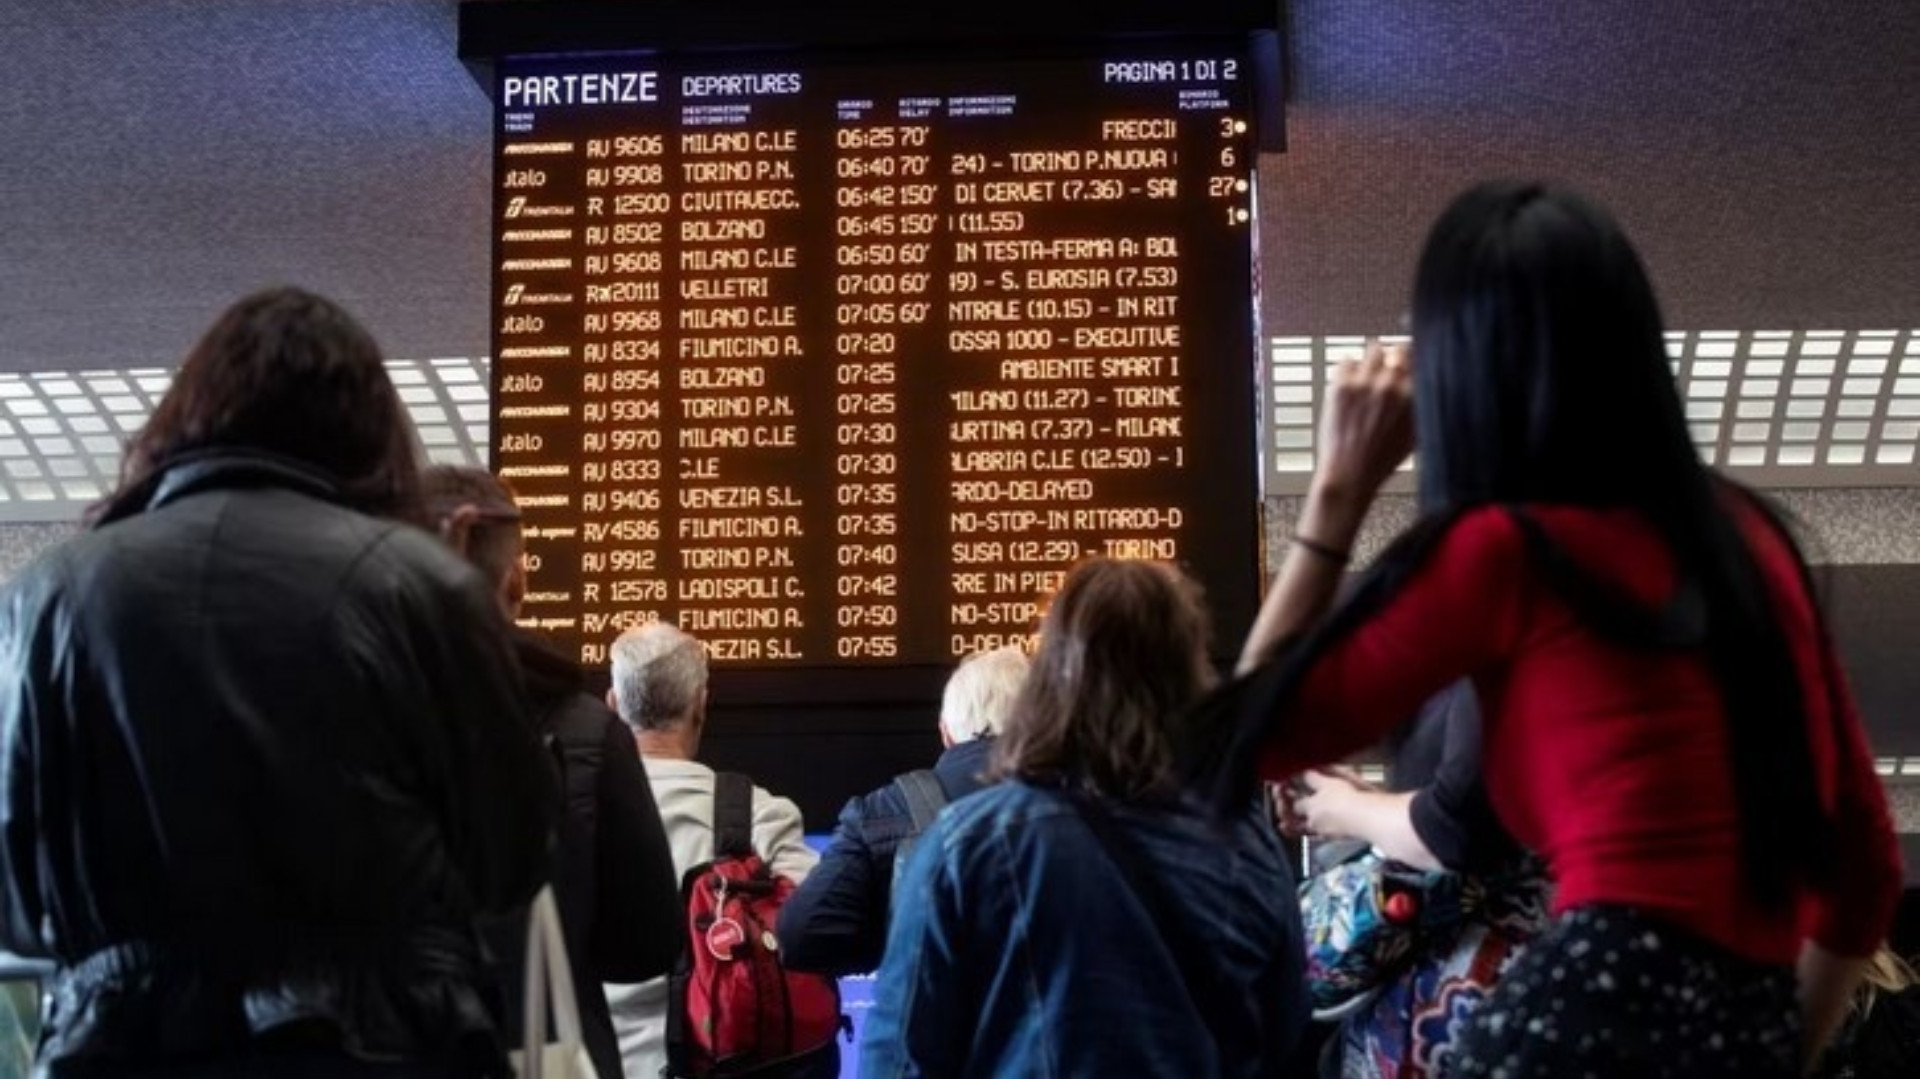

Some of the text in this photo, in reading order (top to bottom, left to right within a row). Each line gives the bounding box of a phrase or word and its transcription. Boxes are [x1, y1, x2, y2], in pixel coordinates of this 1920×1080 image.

[1104, 59, 1237, 82] PAGINA 1 DI 2
[504, 71, 657, 107] PARTENZE
[682, 73, 801, 97] DEPARTURES
[837, 126, 895, 149] 06:25
[1220, 117, 1233, 138] 3
[614, 135, 663, 157] 9606
[681, 130, 797, 154] MILANO C.LE
[837, 156, 895, 178] 06:40
[1010, 150, 1080, 173] TORINO
[1085, 148, 1167, 170] P.NUOVA
[1220, 146, 1235, 167] 6
[613, 163, 663, 186] 9908
[682, 160, 794, 183] TORINO P.N.
[837, 185, 895, 207] 06:42
[955, 183, 977, 204] DI
[983, 181, 1055, 200] CERVET
[1062, 179, 1123, 200] (7.36)
[1209, 177, 1234, 197] 27
[587, 197, 604, 215] R
[614, 192, 670, 215] 12500
[681, 189, 800, 213] CIVITAVECC.
[837, 214, 895, 237] 06:45
[959, 211, 1024, 233] (11.55)
[1227, 206, 1235, 225] 1
[612, 222, 662, 244] 8502
[681, 218, 765, 242] BOLZANO
[681, 247, 796, 270] MILANO C.LE
[837, 244, 895, 266] 06:50
[956, 242, 977, 263] IN
[983, 238, 1114, 262] TESTA-FERMA
[1118, 237, 1139, 258] A:
[612, 251, 662, 273] 9608
[680, 277, 768, 300] VELLETRI
[837, 273, 895, 295] 07:00
[1001, 266, 1178, 291] S. EUROSIA (7.53)
[612, 281, 660, 303] 20111
[680, 306, 796, 329] MILANO C.LE
[837, 303, 895, 325] 07:05
[1027, 298, 1092, 319] (10.15)
[1117, 297, 1139, 318] IN
[1143, 296, 1177, 317] RIT
[612, 310, 662, 332] 9968
[679, 335, 803, 359] FIUMICINO A.
[837, 332, 895, 355] 07:20
[949, 325, 1180, 352] OSSA 1000 EXECUTIVE
[612, 340, 660, 361] 8334
[680, 366, 765, 389] BOLZANO
[837, 362, 895, 385] 07:25
[1001, 356, 1163, 380] AMBIENTE SMART
[611, 369, 660, 391] 8954
[611, 399, 660, 421] 9304
[680, 395, 794, 419] TORINO P.N.
[837, 393, 895, 414] 07:25
[1023, 388, 1089, 410] (11.27)
[610, 429, 661, 451] 9970
[679, 425, 796, 448] MILANO C.LE
[837, 422, 896, 445] 07:30
[1030, 418, 1093, 440] (7.37)
[610, 459, 661, 481] 8333
[837, 453, 896, 475] 07:30
[1031, 449, 1075, 471] C.LE
[1080, 447, 1151, 469] (12.50)
[610, 488, 660, 511] 9406
[679, 486, 803, 509] VENEZIA S.L.
[837, 483, 896, 505] 07:35
[610, 519, 660, 541] 4586
[679, 515, 803, 539] FIUMICINO A.
[837, 513, 896, 535] 07:35
[951, 507, 1182, 533] NO-STOP-IN RITARDO-D
[610, 549, 656, 571] 9912
[679, 546, 794, 569] TORINO P.N.
[837, 544, 897, 566] 07:40
[951, 539, 1176, 564] SUSA (12.29) TORINO
[583, 583, 600, 602] R
[610, 579, 668, 602] 12578
[679, 576, 805, 600] LADISPOLI C.
[837, 574, 897, 596] 07:42
[994, 572, 1016, 593] IN
[679, 607, 803, 630] FIUMICINO A.
[837, 605, 897, 627] 07:50
[765, 637, 803, 659] S.L.
[837, 635, 897, 657] 07:55
